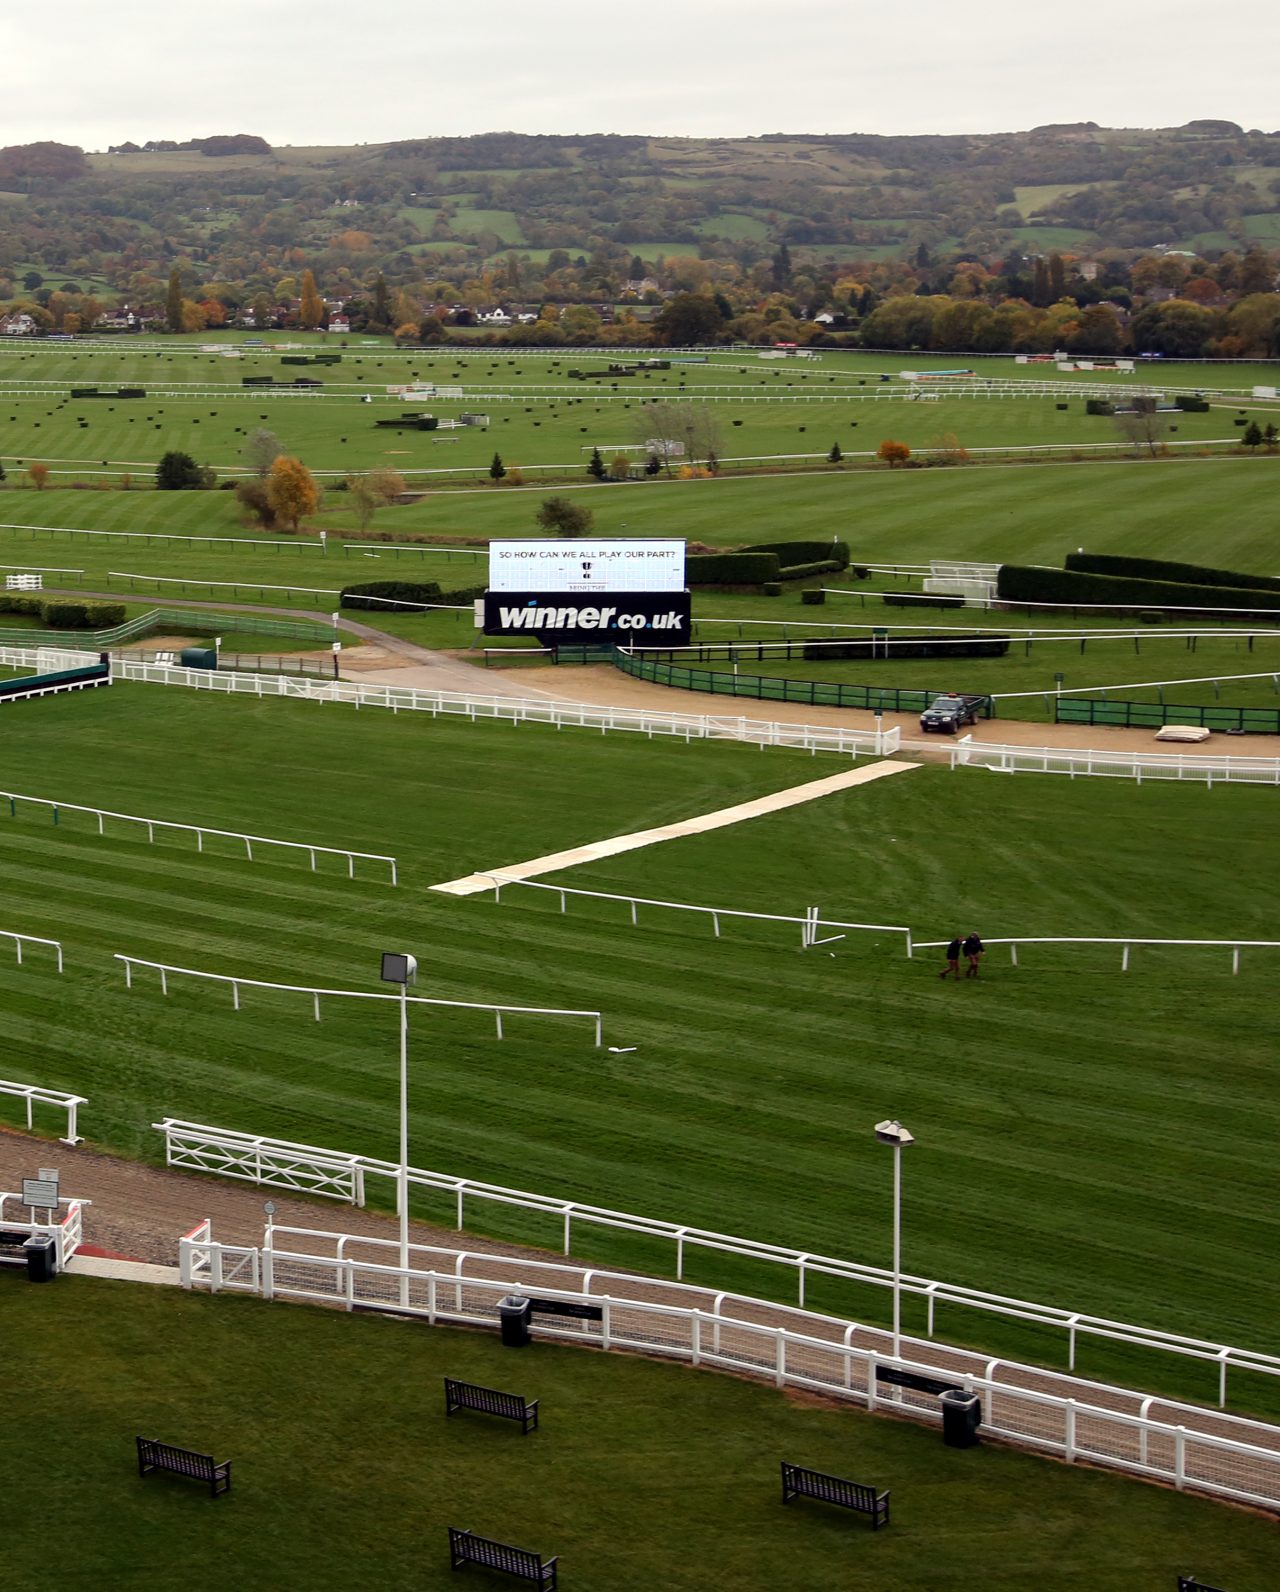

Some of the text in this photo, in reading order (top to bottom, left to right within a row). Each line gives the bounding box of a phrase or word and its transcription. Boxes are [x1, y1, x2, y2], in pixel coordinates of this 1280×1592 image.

[499, 551, 676, 559] SO HOW CAN WE ALL PLAY OUR PART?
[498, 600, 684, 630] winner.co.uk
